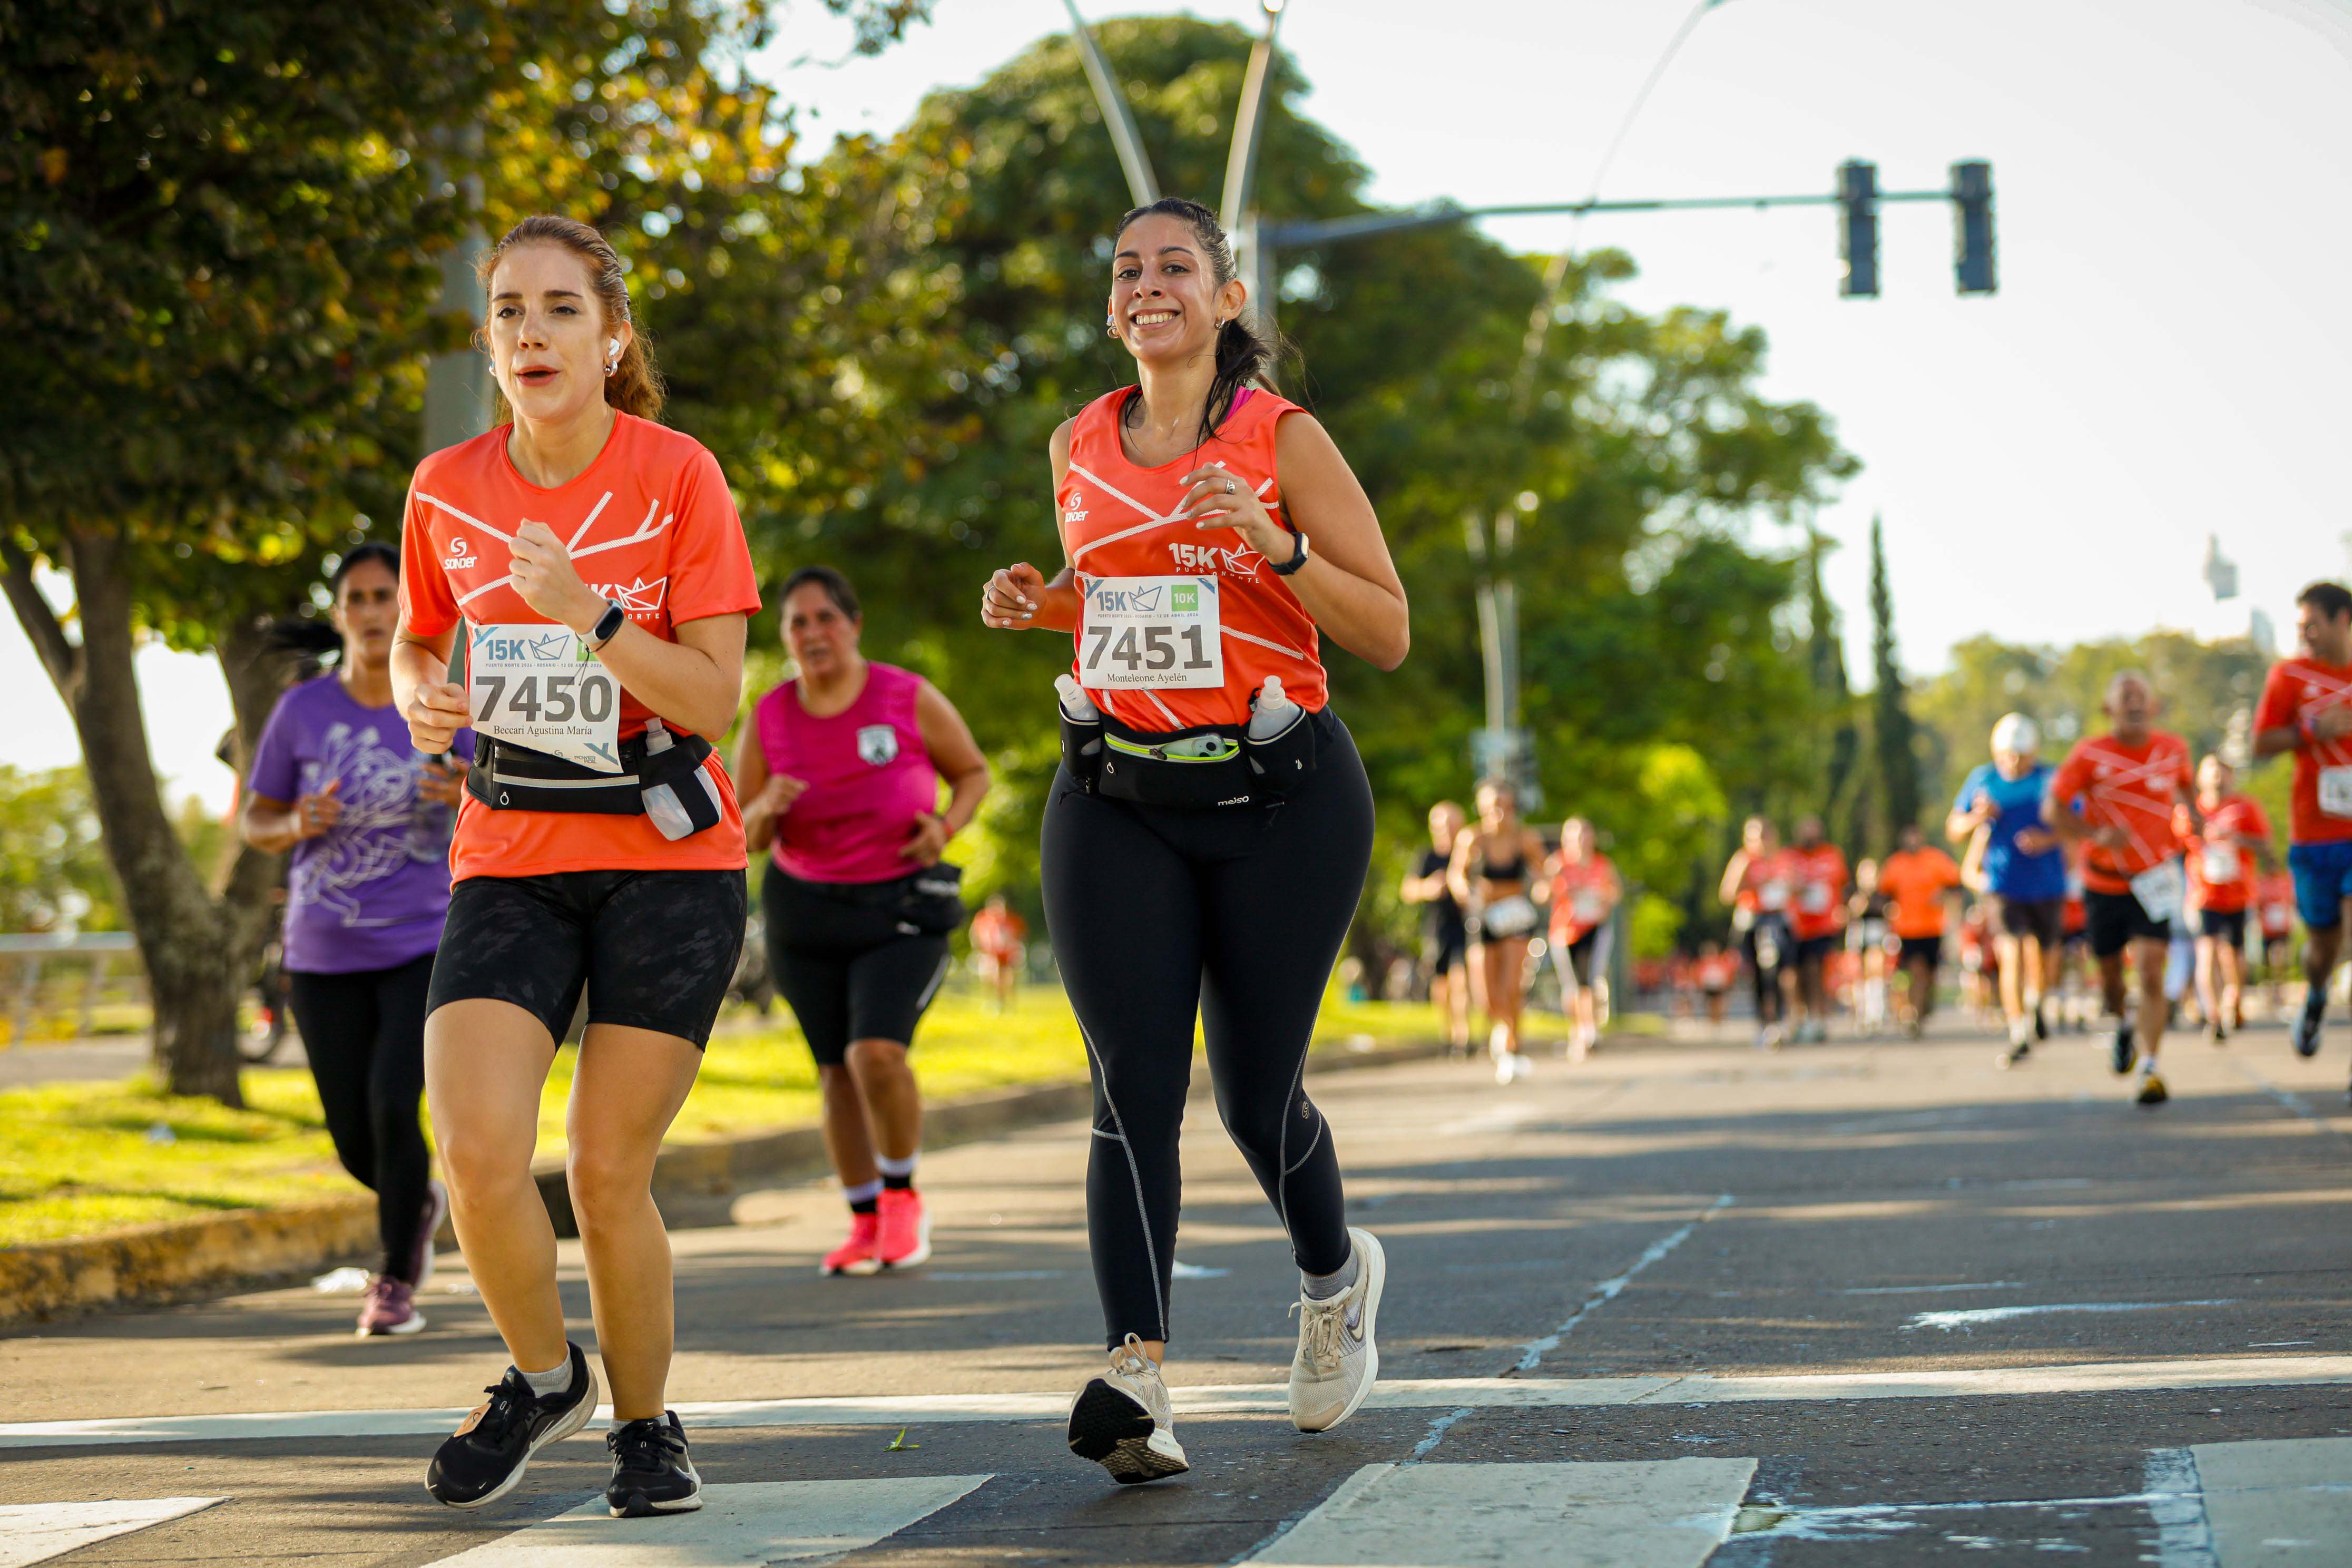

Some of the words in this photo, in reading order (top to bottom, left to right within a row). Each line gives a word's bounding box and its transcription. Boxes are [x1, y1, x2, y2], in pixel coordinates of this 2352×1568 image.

[1169, 543, 1219, 569] 15K
[1096, 591, 1127, 611] 15K
[1174, 593, 1195, 603] 10K
[485, 639, 526, 660] 15K
[1086, 624, 1213, 670] 7451
[1107, 673, 1155, 682] Monteleone
[1158, 673, 1187, 683] Ayelén
[476, 675, 612, 722] 7450
[493, 725, 524, 734] Beccari
[527, 725, 564, 737] Agustina
[567, 725, 592, 735] María
